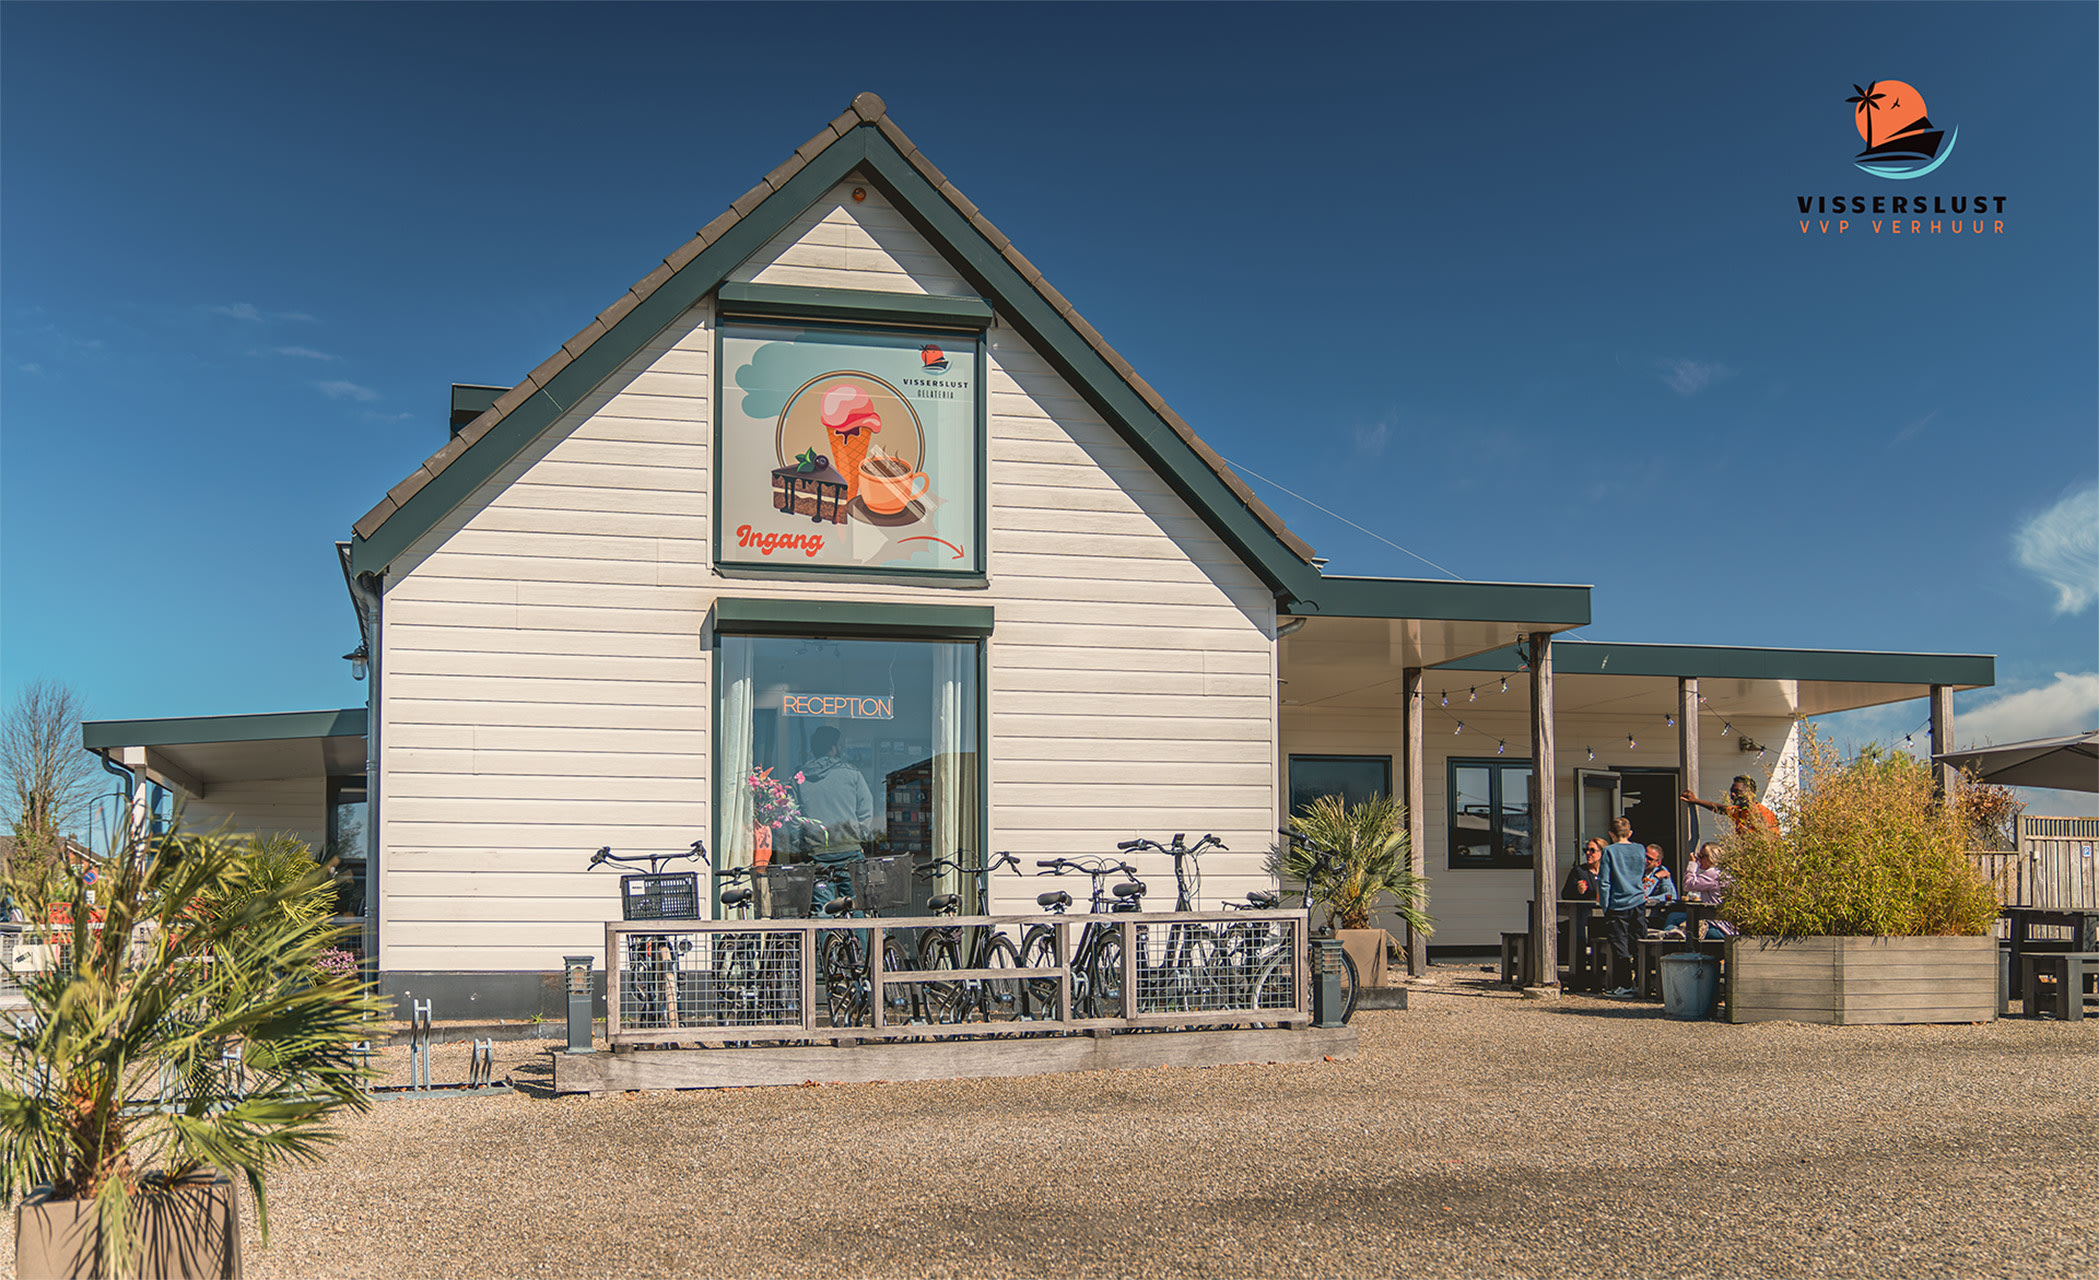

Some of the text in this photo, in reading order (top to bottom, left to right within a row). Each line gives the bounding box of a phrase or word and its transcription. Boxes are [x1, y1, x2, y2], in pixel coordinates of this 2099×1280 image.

[903, 378, 968, 389] VISSERSLUST
[917, 389, 954, 399] GELATERIA
[736, 524, 825, 558] Ingang
[783, 695, 892, 717] RECEPTION
